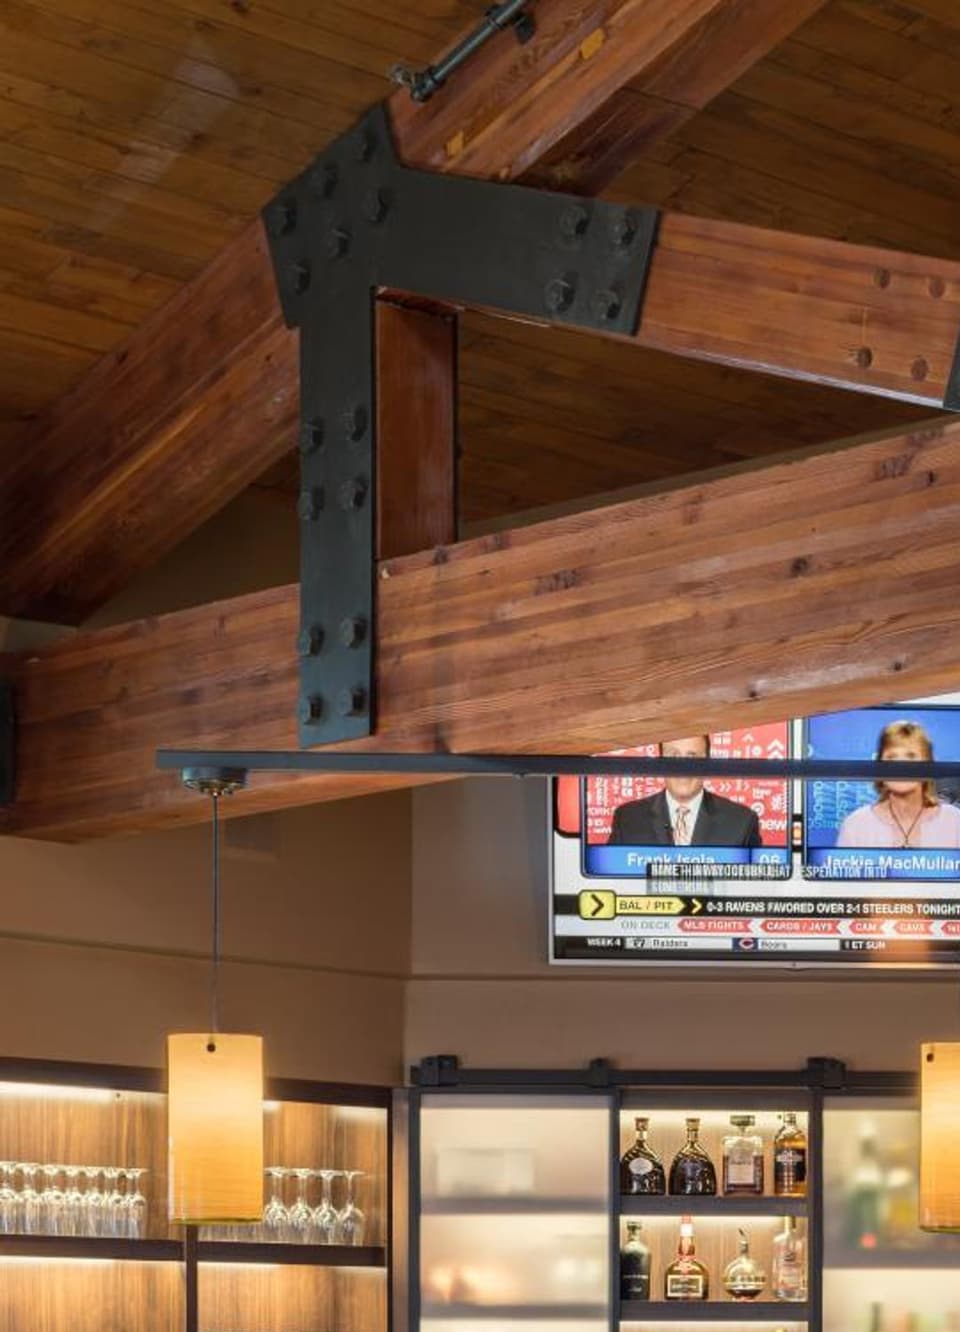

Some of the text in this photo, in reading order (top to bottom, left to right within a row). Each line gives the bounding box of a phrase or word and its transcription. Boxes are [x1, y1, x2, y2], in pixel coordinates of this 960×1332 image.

[619, 901, 641, 910] BAL
[654, 901, 673, 911] PIT
[706, 901, 724, 912] 0-3
[725, 901, 765, 912] RAVENS
[767, 902, 814, 914] FAVORED
[816, 902, 845, 914] OVER
[862, 903, 914, 915] STEELERS
[620, 920, 671, 930] ON DECK
[586, 938, 612, 947] WEEK
